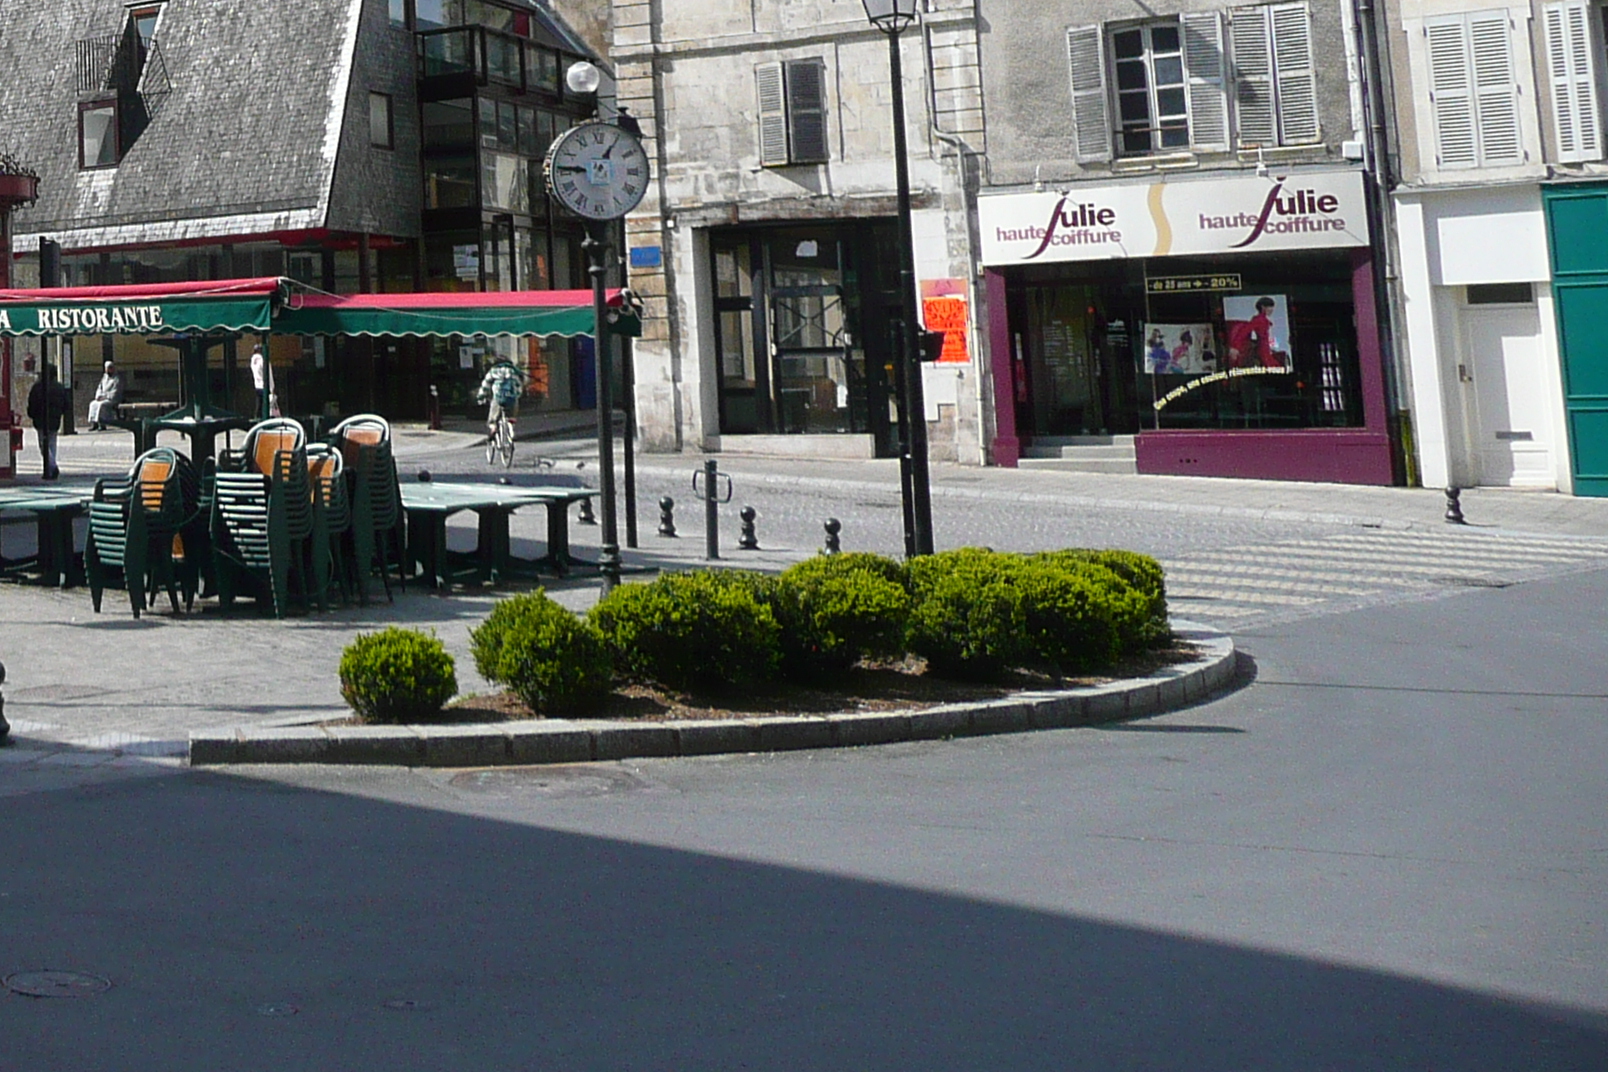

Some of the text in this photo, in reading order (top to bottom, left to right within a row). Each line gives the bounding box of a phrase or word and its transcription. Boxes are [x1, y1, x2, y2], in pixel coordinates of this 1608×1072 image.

[1199, 212, 1346, 234] haute coiffure
[996, 226, 1122, 246] haute coiffure
[37, 305, 163, 329] RISTORANTE
